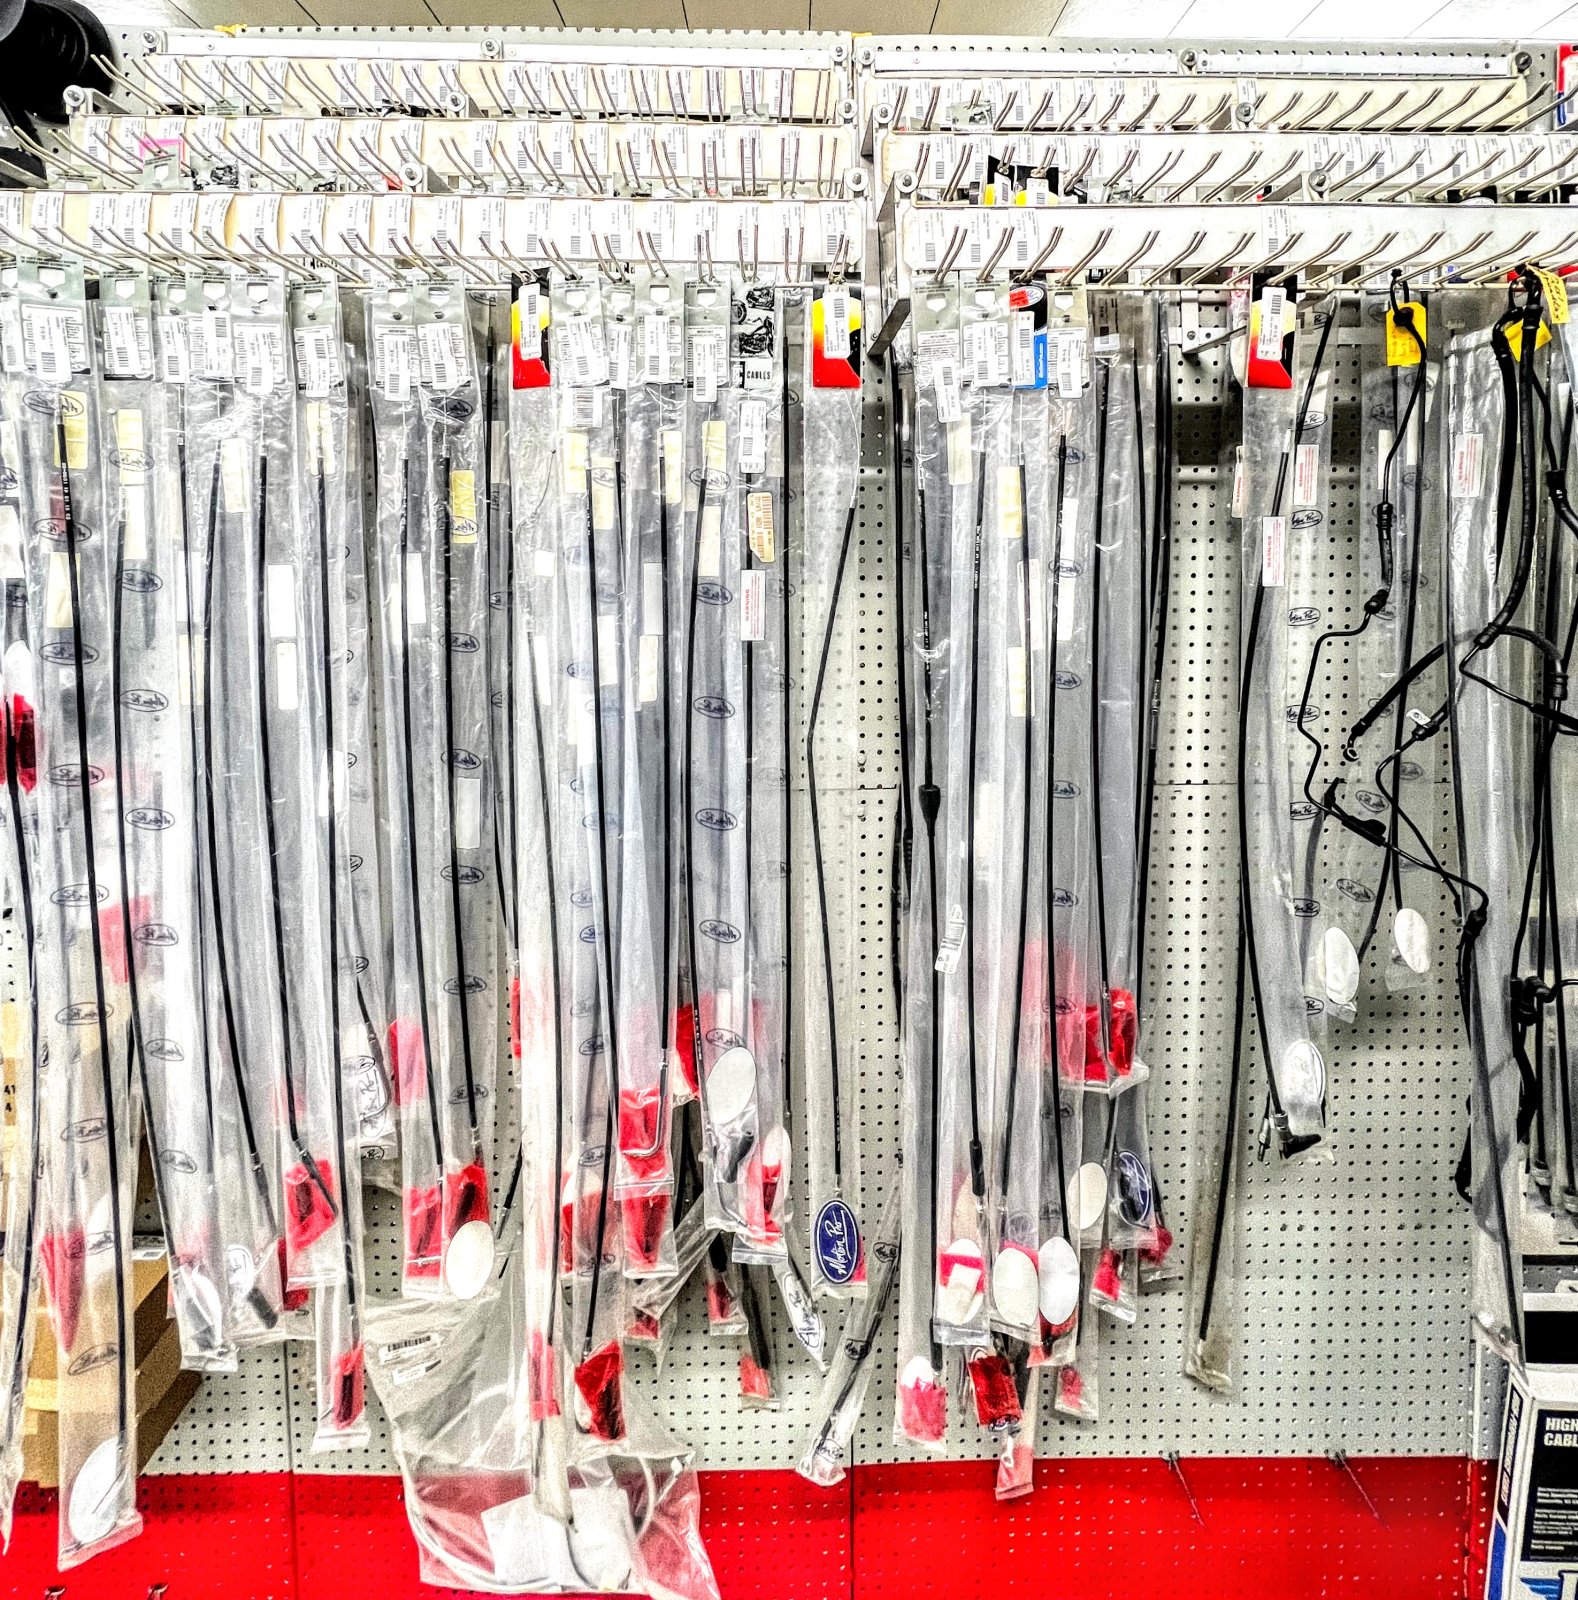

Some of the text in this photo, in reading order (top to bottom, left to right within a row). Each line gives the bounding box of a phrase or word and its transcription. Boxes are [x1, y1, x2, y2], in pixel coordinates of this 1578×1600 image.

[746, 370, 771, 380] CABLES
[823, 1210, 849, 1276] Motion Pro
